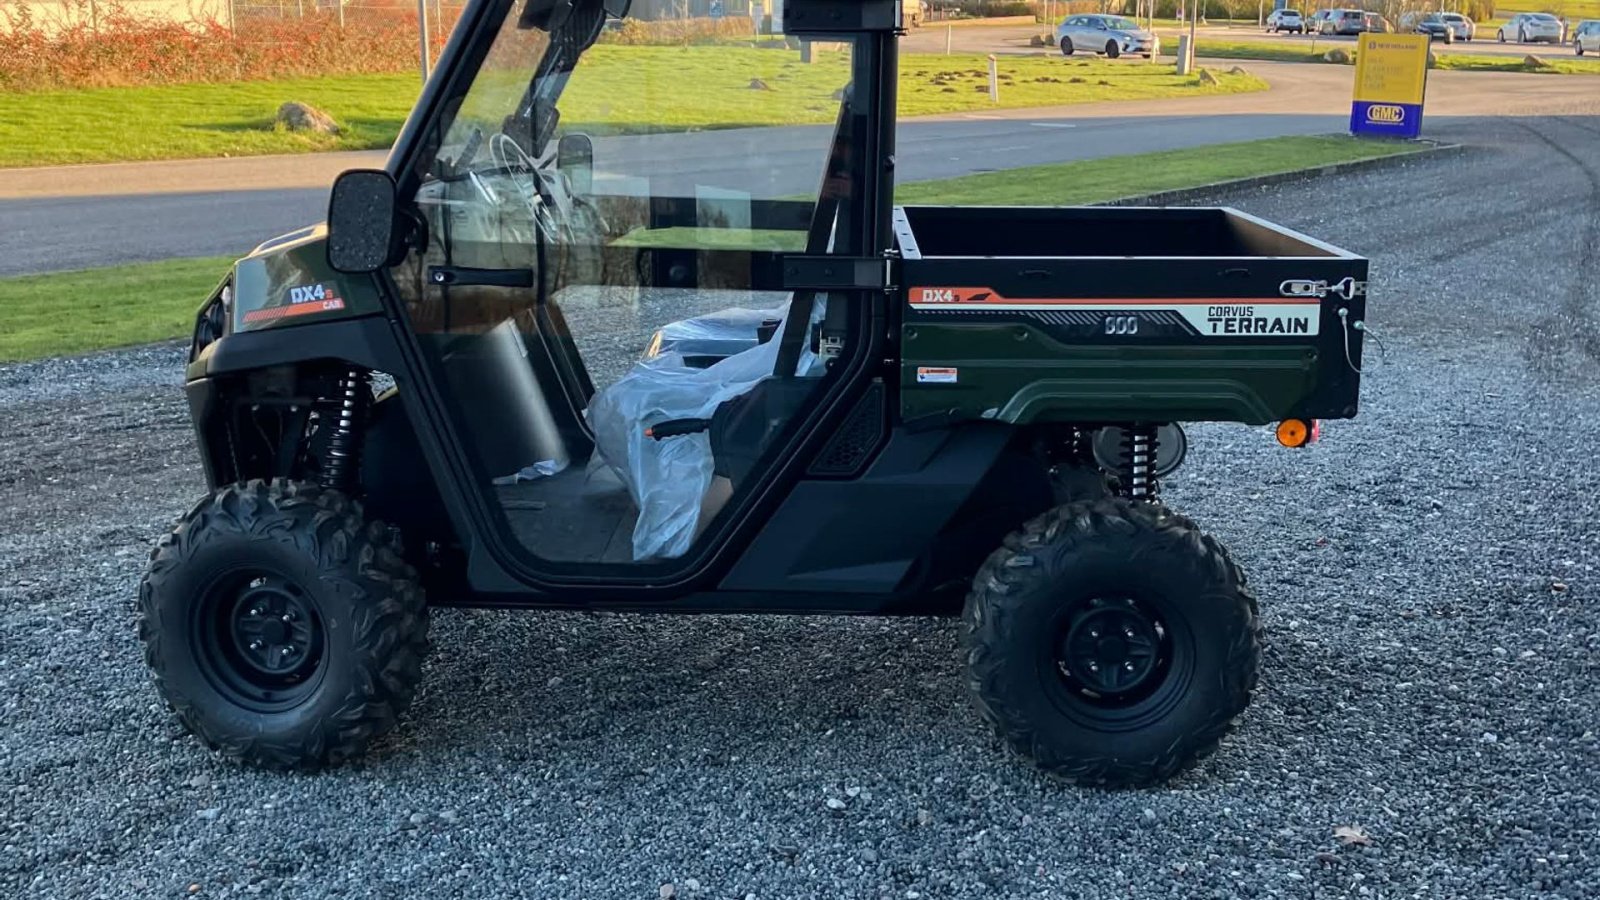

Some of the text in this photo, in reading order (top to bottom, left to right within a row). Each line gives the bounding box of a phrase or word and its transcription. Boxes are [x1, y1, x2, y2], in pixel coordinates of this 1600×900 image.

[1371, 106, 1400, 121] GMC
[1208, 306, 1254, 317] CORVUS
[1207, 317, 1308, 334] TERRAIN
